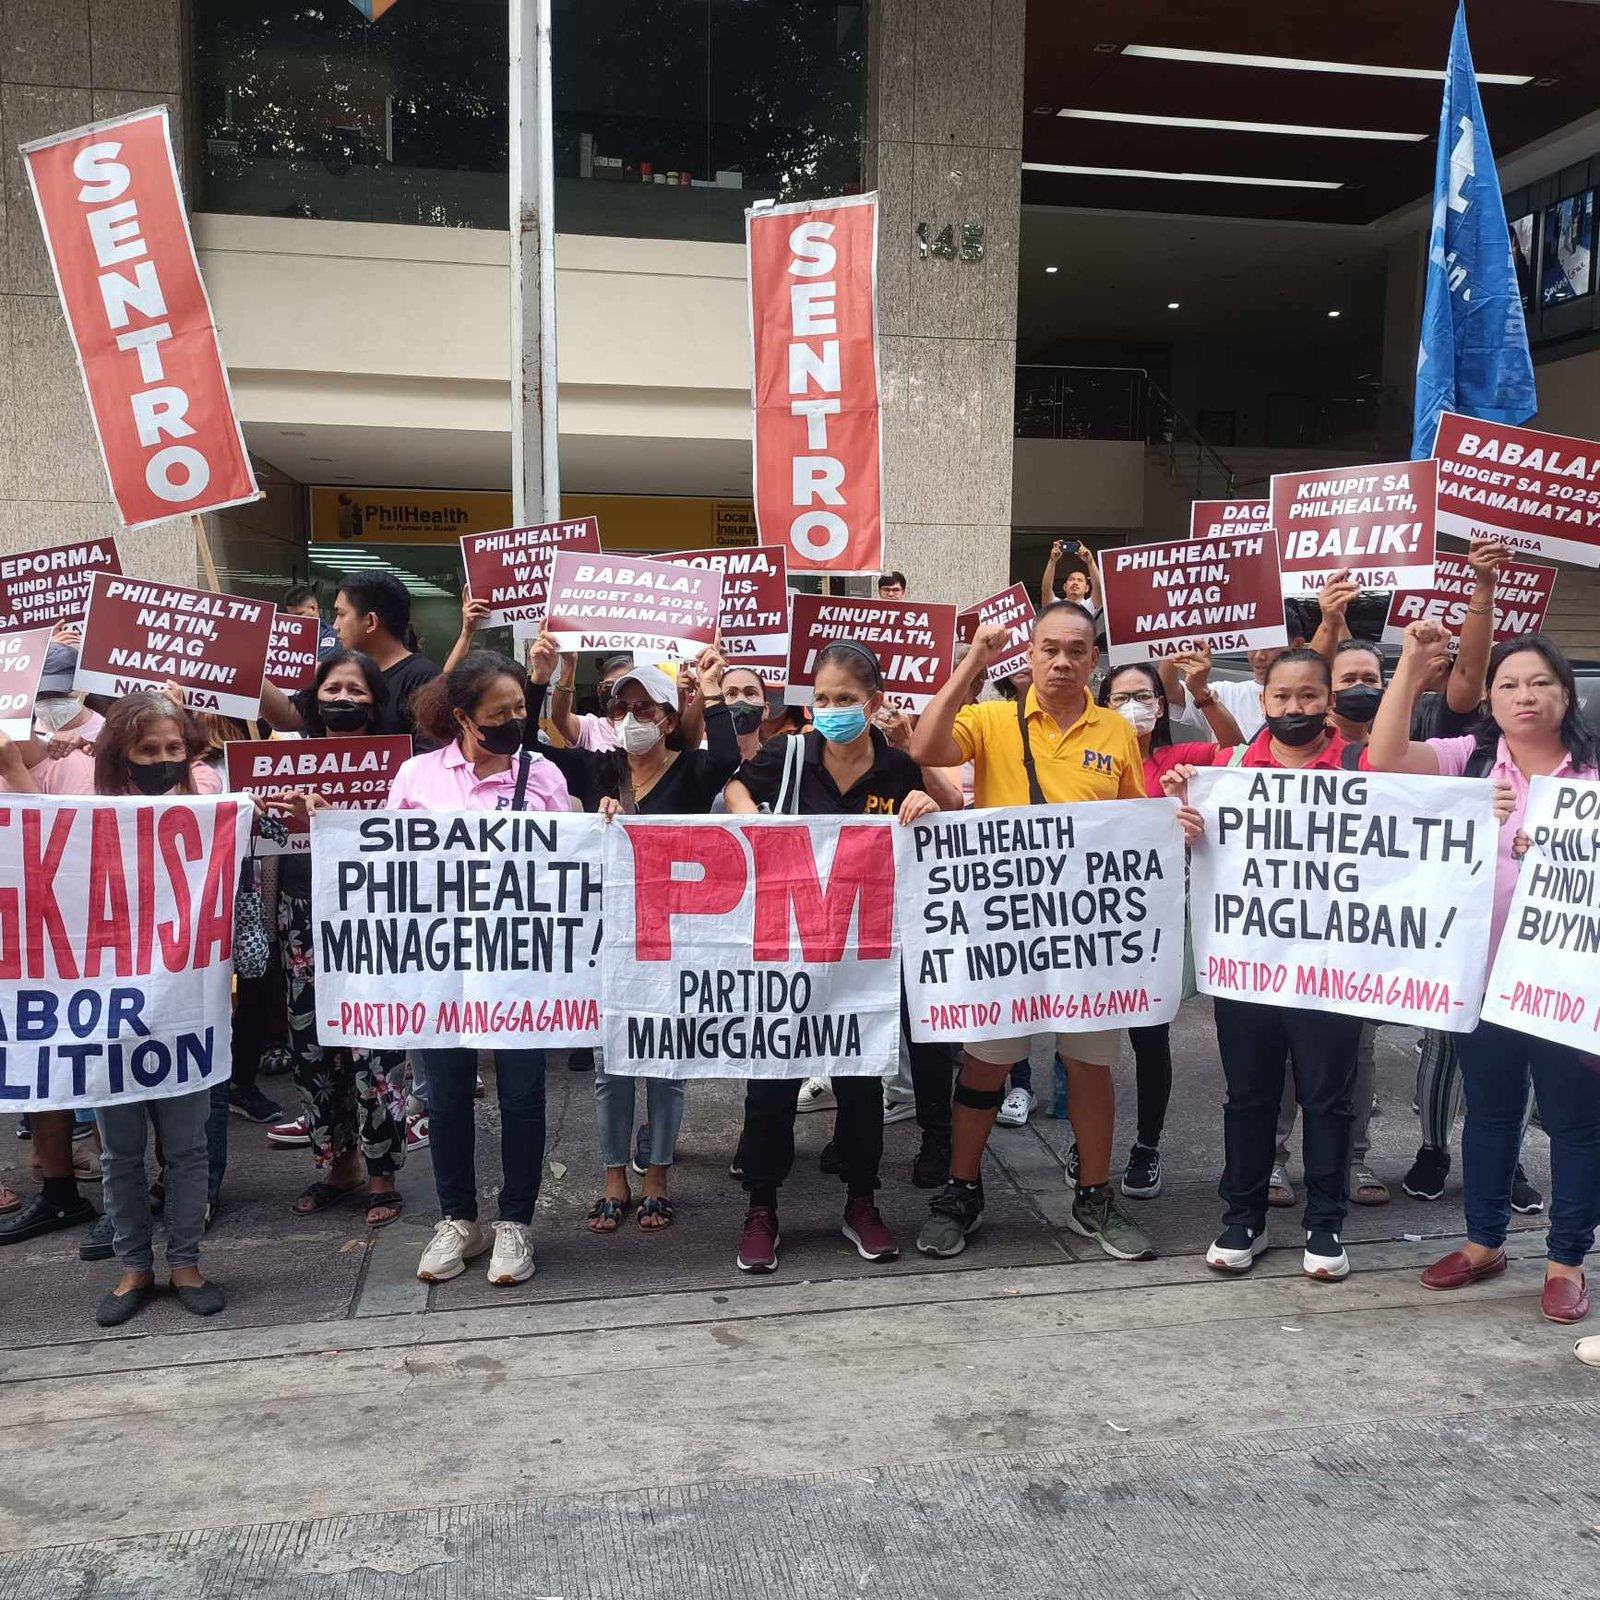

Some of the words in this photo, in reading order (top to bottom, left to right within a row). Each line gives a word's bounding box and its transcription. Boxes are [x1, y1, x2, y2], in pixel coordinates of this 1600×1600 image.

[915, 222, 984, 262] 145
[73, 141, 210, 502] SENTRO
[787, 221, 849, 561] SENTRO
[1456, 433, 1600, 481] BABALA!
[1296, 476, 1379, 500] KINUPIT
[1382, 473, 1410, 491] SA
[1441, 460, 1515, 487] BUDGET
[1516, 477, 1541, 493] SA
[365, 505, 468, 523] PhilHealth
[717, 511, 749, 523] Local
[1289, 494, 1418, 520] PHILHEALTH,
[1438, 479, 1600, 528] NAKAMAMATAY
[474, 523, 587, 553] PHILHEALTH
[1116, 537, 1263, 572] PHILHEALTH
[1285, 522, 1423, 560] IBALIK!
[7, 577, 52, 597] HINDI
[492, 581, 550, 603] NAKA
[574, 565, 701, 594] BABALA!
[1152, 563, 1230, 588] NATIN,
[106, 581, 261, 623] PHILHEALTH
[560, 588, 630, 602] BUDGET
[633, 591, 656, 605] SA
[659, 594, 708, 613] 2025,
[1167, 586, 1221, 607] WAG
[136, 608, 219, 641] NATIN,
[552, 604, 715, 629] NAKAMAMATAY!
[817, 606, 900, 625] KINUPIT
[903, 611, 929, 627] SA
[1136, 602, 1257, 633] NAKAWIN!
[147, 632, 204, 657] WAG
[580, 634, 679, 653] NAGKAISA
[808, 623, 936, 649] PHILHEALTH,
[108, 648, 237, 684] NAKAWIN!
[252, 750, 390, 778] BABALA!
[1082, 749, 1112, 773] PM
[321, 782, 345, 795] SA
[864, 794, 895, 815] PM
[1248, 772, 1367, 806] ATING
[1553, 787, 1600, 820] PO
[359, 817, 557, 852] SIBAKIN
[913, 816, 1075, 862] PHILHEALTH
[1218, 806, 1483, 876] PHILHEALTH,
[338, 860, 603, 913] PHILHEALTH
[928, 854, 1067, 895] SUBSIDY
[1085, 849, 1164, 885] PARA
[1242, 857, 1359, 892] ATING
[1528, 863, 1595, 907] HINDI
[623, 824, 895, 963] PM
[923, 900, 969, 935] SA
[983, 887, 1147, 931] SENIORS
[1214, 893, 1457, 949] IPAGLABAN!
[321, 917, 603, 975] MANAGEMENT!
[919, 948, 954, 984] AT
[966, 928, 1161, 982] INDIGENTS!
[679, 970, 812, 1013] PARTIDO
[1200, 956, 1288, 993] -PARTIDO
[1296, 964, 1464, 1014] MANGGAGAWA-
[1500, 980, 1585, 1024] -PARTIDO
[0, 987, 152, 1041] BOR
[327, 1002, 426, 1037] -PARTIDO
[436, 1000, 603, 1035] MANGGAGAWA
[920, 1001, 1001, 1031] -PARTIDO
[1011, 988, 1162, 1024] MANGGAGAWA-
[628, 1013, 861, 1060] MANGGAGAWA
